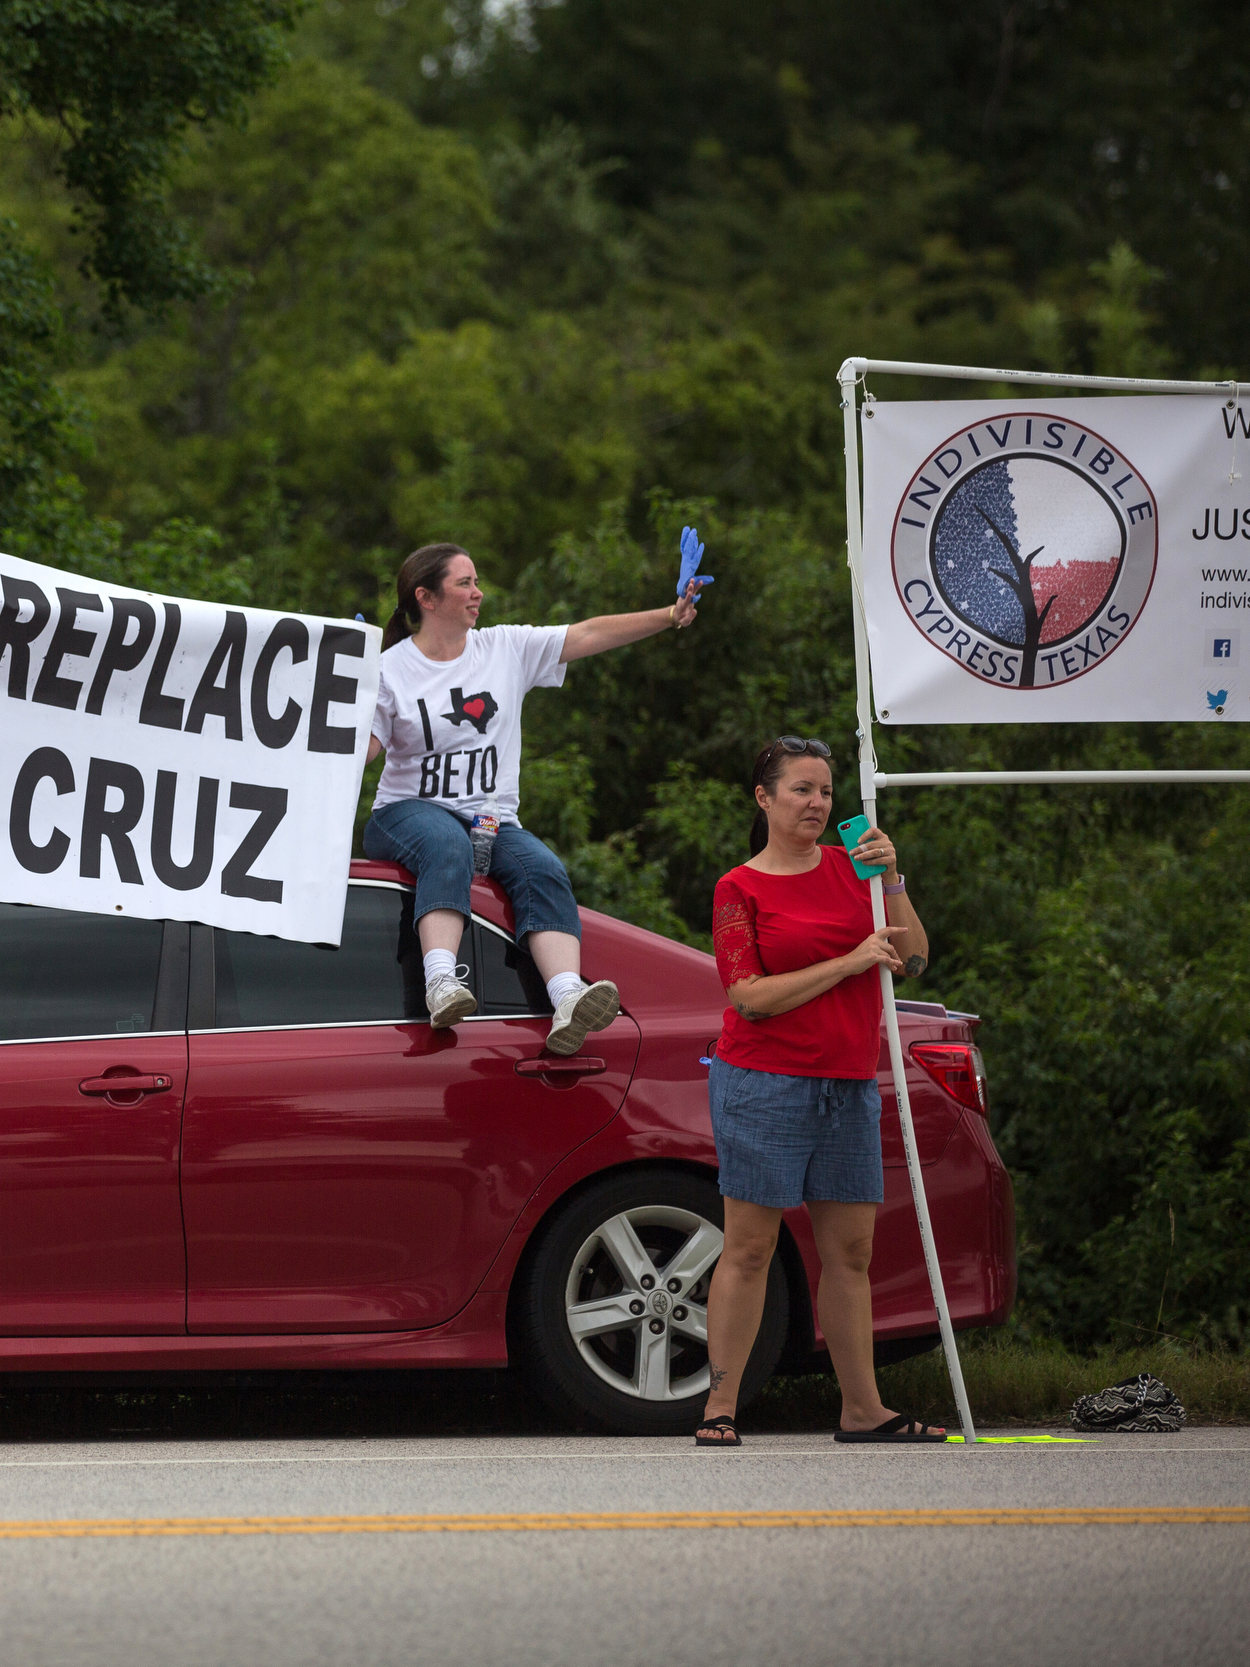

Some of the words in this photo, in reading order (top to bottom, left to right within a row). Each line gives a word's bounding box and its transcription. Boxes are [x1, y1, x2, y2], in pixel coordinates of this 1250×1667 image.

[901, 418, 1153, 529] INDIVISIBLE
[903, 579, 1019, 684] CYPRESS
[1041, 605, 1131, 682] TEXAS
[416, 698, 435, 752] I
[418, 744, 499, 799] BETO
[9, 746, 289, 905] CRUZ
